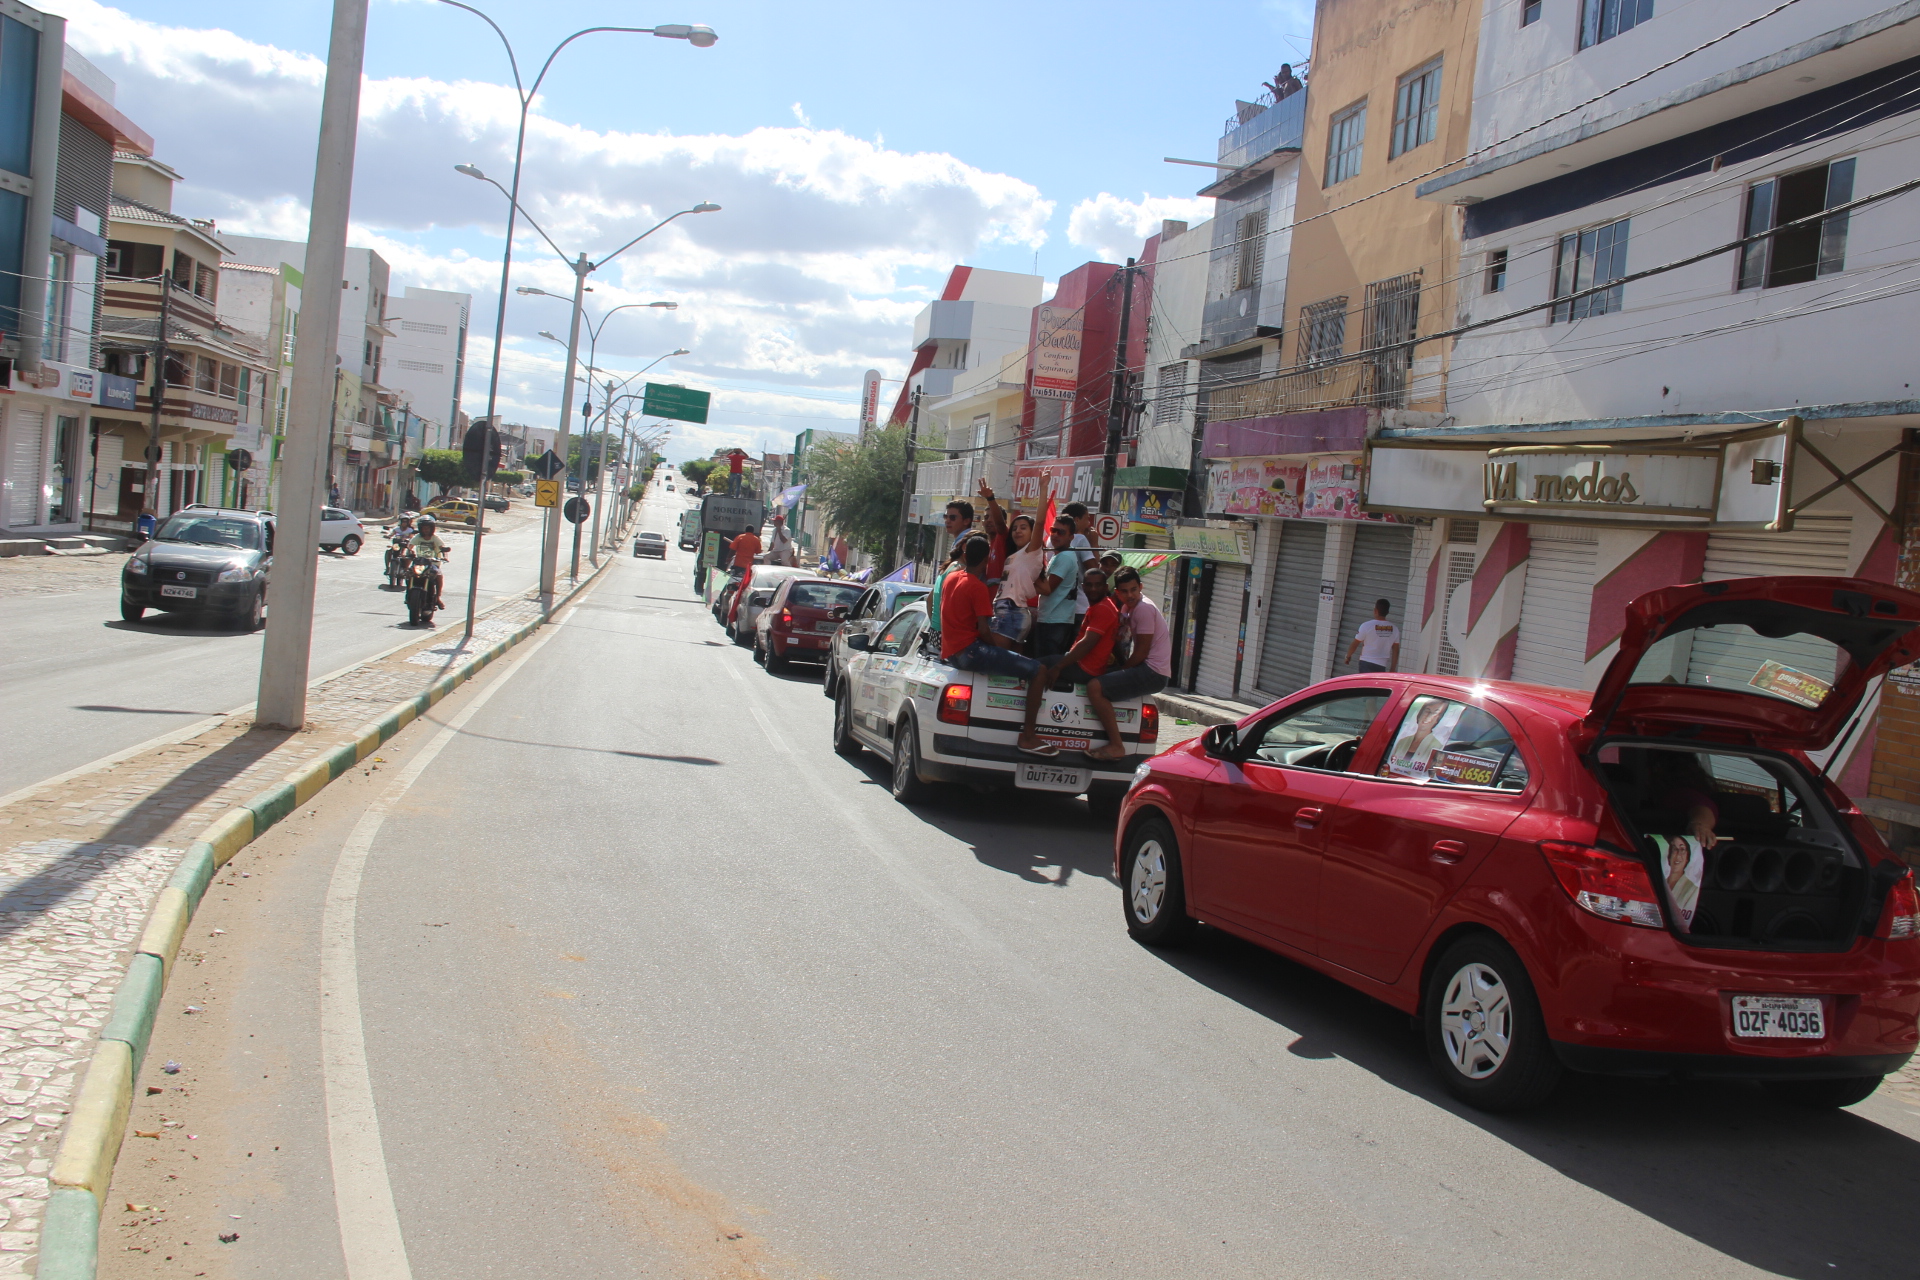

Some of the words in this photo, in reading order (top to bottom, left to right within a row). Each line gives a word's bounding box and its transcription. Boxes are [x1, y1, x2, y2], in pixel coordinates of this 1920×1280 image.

[1038, 330, 1080, 351] Deville
[1043, 351, 1072, 361] Conforto
[1038, 363, 1074, 374] Segurança
[1533, 460, 1640, 502] modas
[713, 505, 752, 516] MOREIRA
[713, 514, 731, 523] SOM
[1103, 521, 1113, 535] E
[1062, 729, 1094, 737] CROSS
[1064, 739, 1087, 748] 1350
